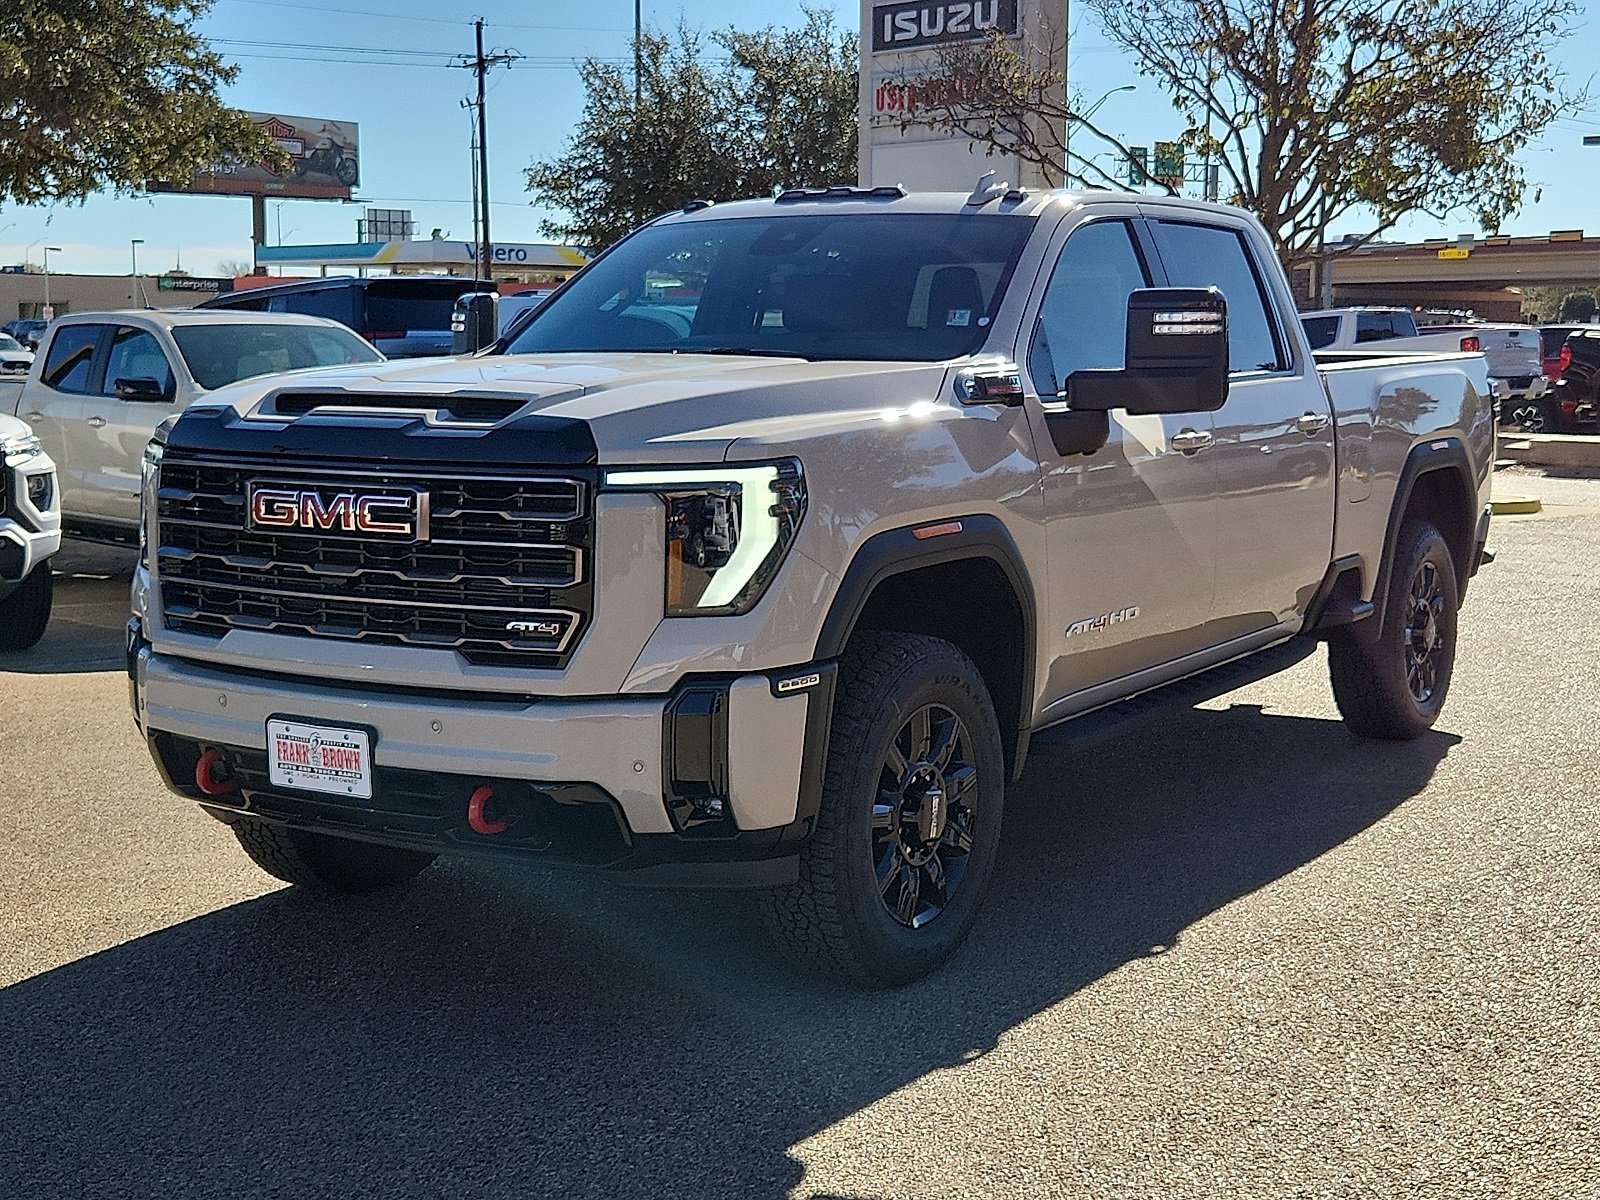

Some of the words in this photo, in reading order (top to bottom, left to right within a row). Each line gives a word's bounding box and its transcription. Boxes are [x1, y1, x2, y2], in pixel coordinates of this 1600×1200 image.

[883, 0, 999, 43] ISUZU
[252, 489, 411, 533] GMC
[1109, 605, 1140, 626] HD
[506, 621, 559, 636] AT4
[277, 740, 310, 765] FRANK
[322, 746, 360, 771] BROWN
[279, 763, 296, 771] AUTO
[298, 765, 312, 773] AND
[314, 767, 337, 776] TRUCK
[338, 769, 361, 779] RANCH
